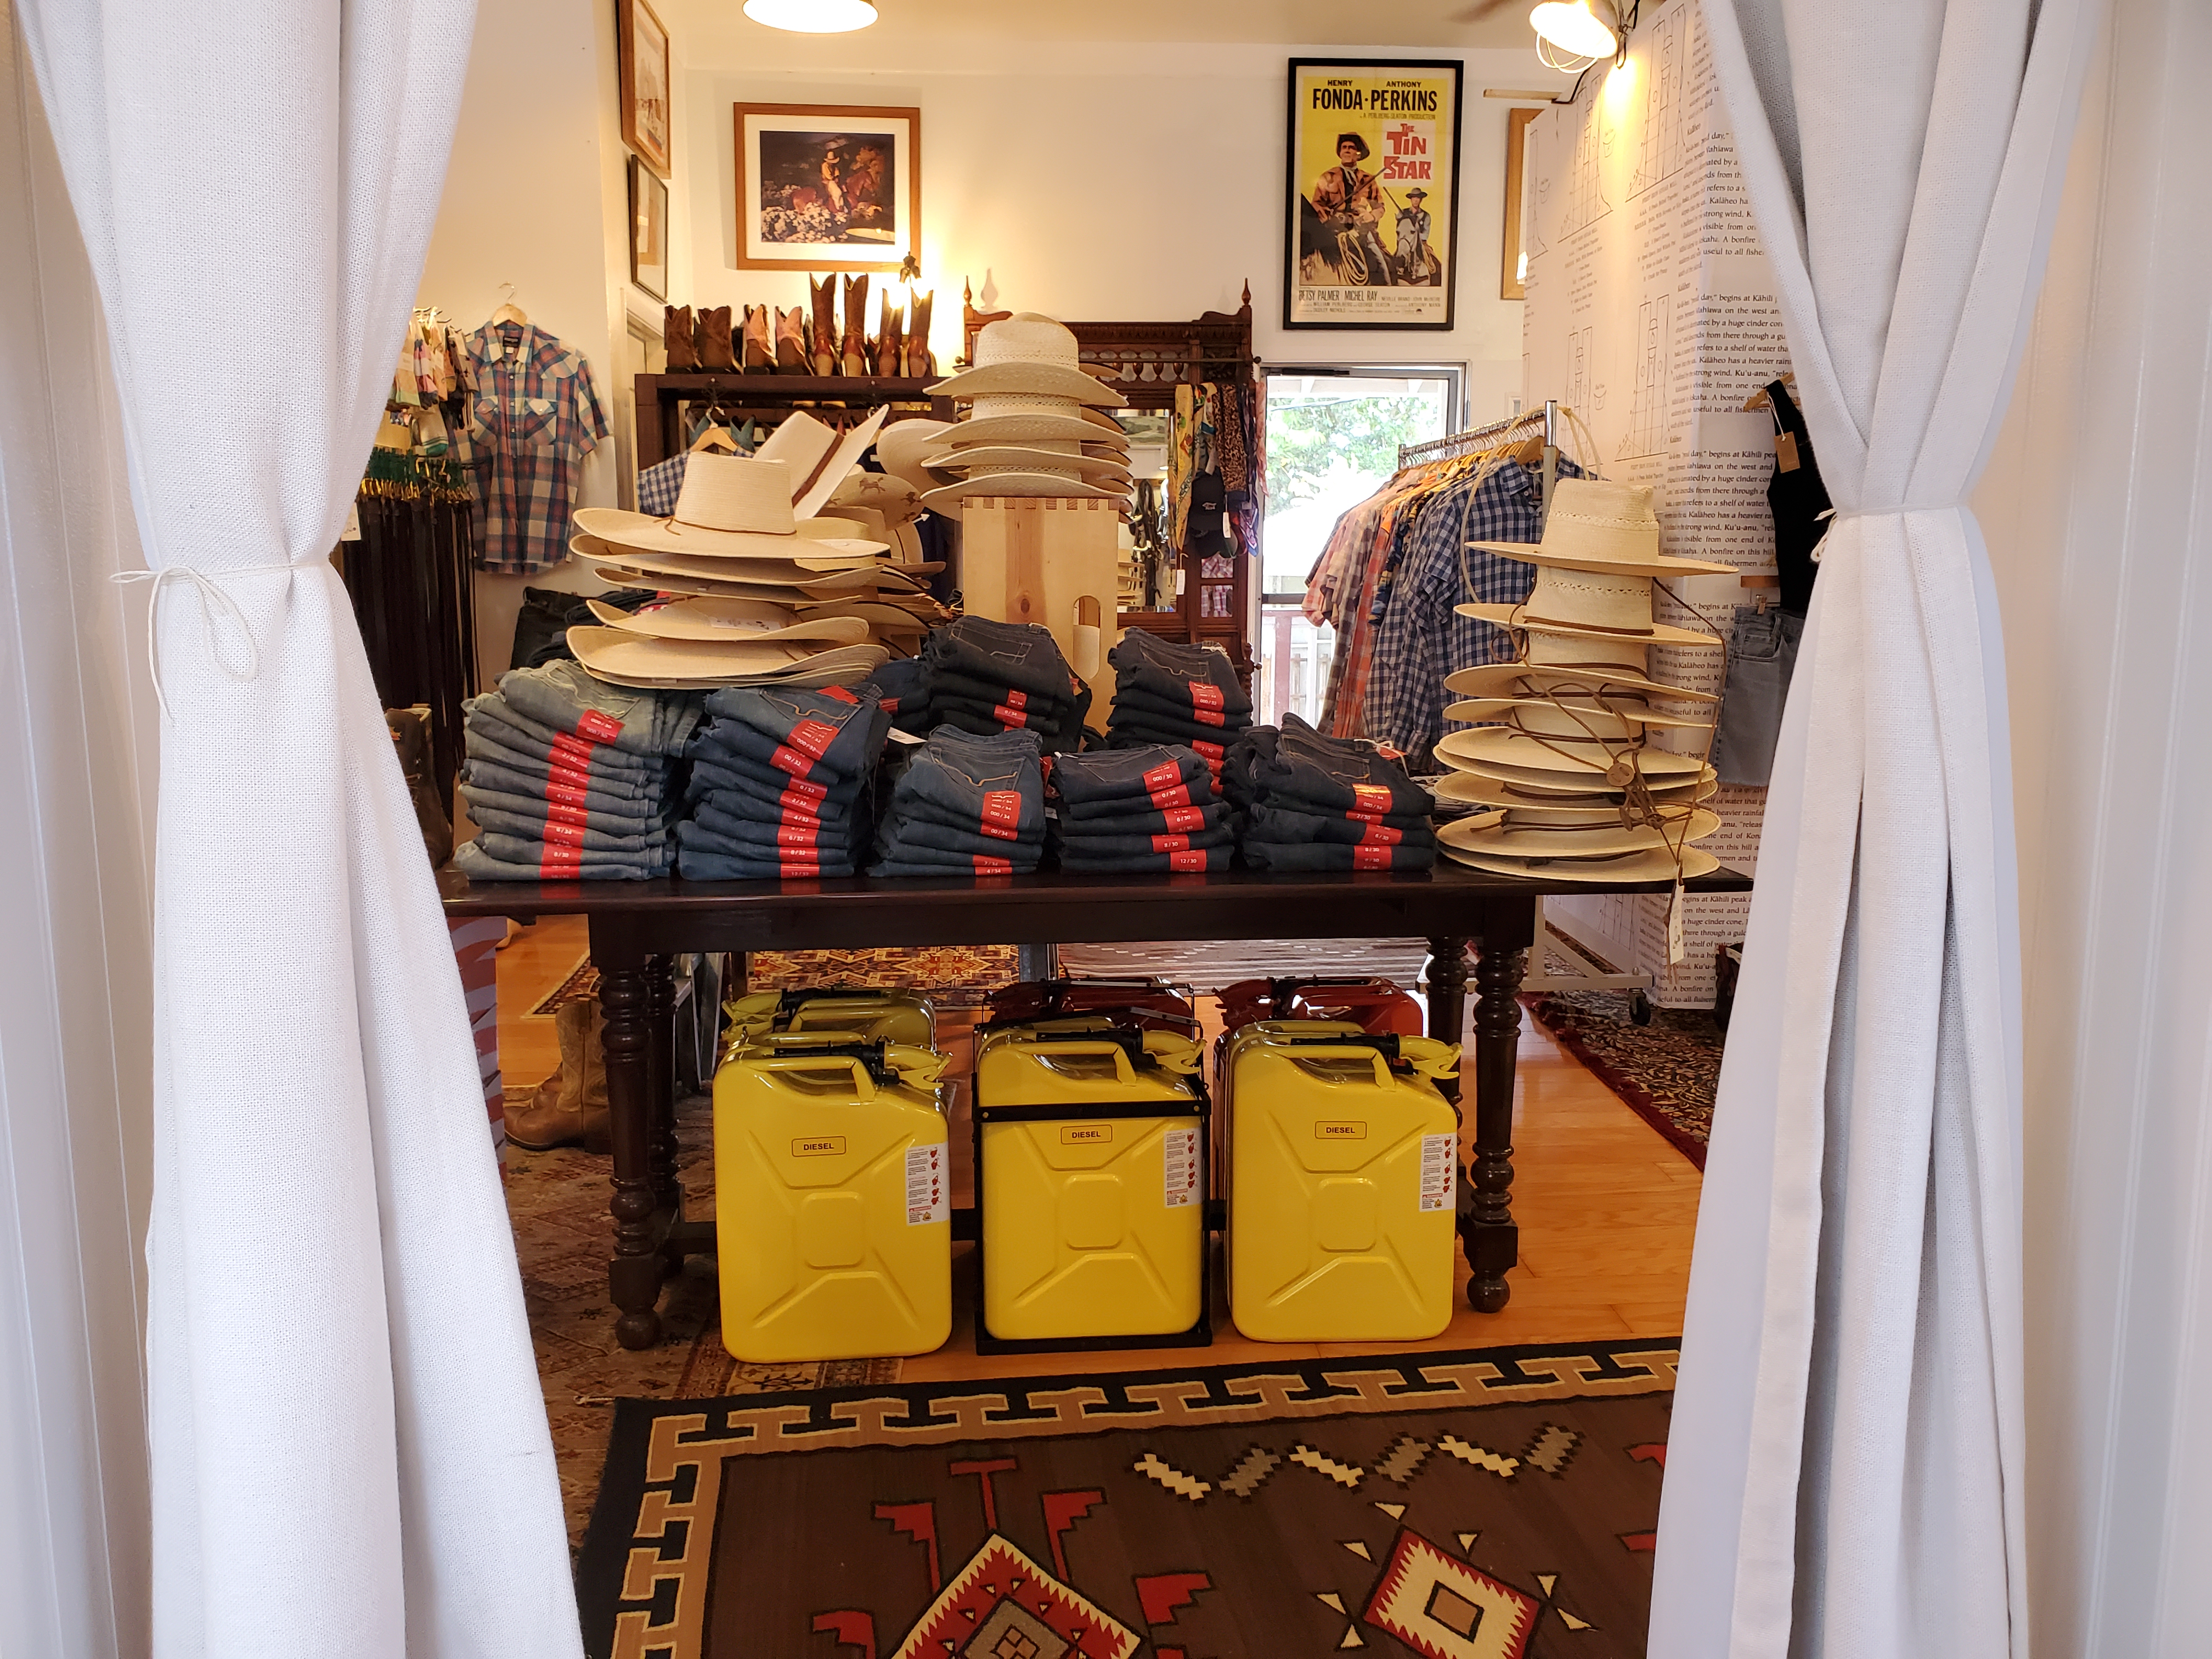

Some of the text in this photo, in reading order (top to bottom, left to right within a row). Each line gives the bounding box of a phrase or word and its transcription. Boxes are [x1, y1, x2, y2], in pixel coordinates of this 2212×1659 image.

[1313, 88, 1437, 111] FONDA PERKINS
[1386, 131, 1426, 155] TIN
[1383, 156, 1431, 179] STAR
[1299, 290, 1378, 301] BETSY PALMER MICHEL RAY
[1719, 294, 1741, 303] begins
[1712, 319, 1720, 328] by
[1728, 319, 1745, 328] huge
[1742, 332, 1769, 341] through
[1748, 357, 1774, 365] heavier
[1708, 450, 1731, 459] begins
[1701, 475, 1711, 483] by
[1717, 475, 1735, 484] huge
[1731, 488, 1758, 496] through
[1719, 499, 1736, 507] shelf
[1698, 603, 1720, 611] begins
[1687, 918, 1703, 926] huge
[1700, 929, 1726, 938] through
